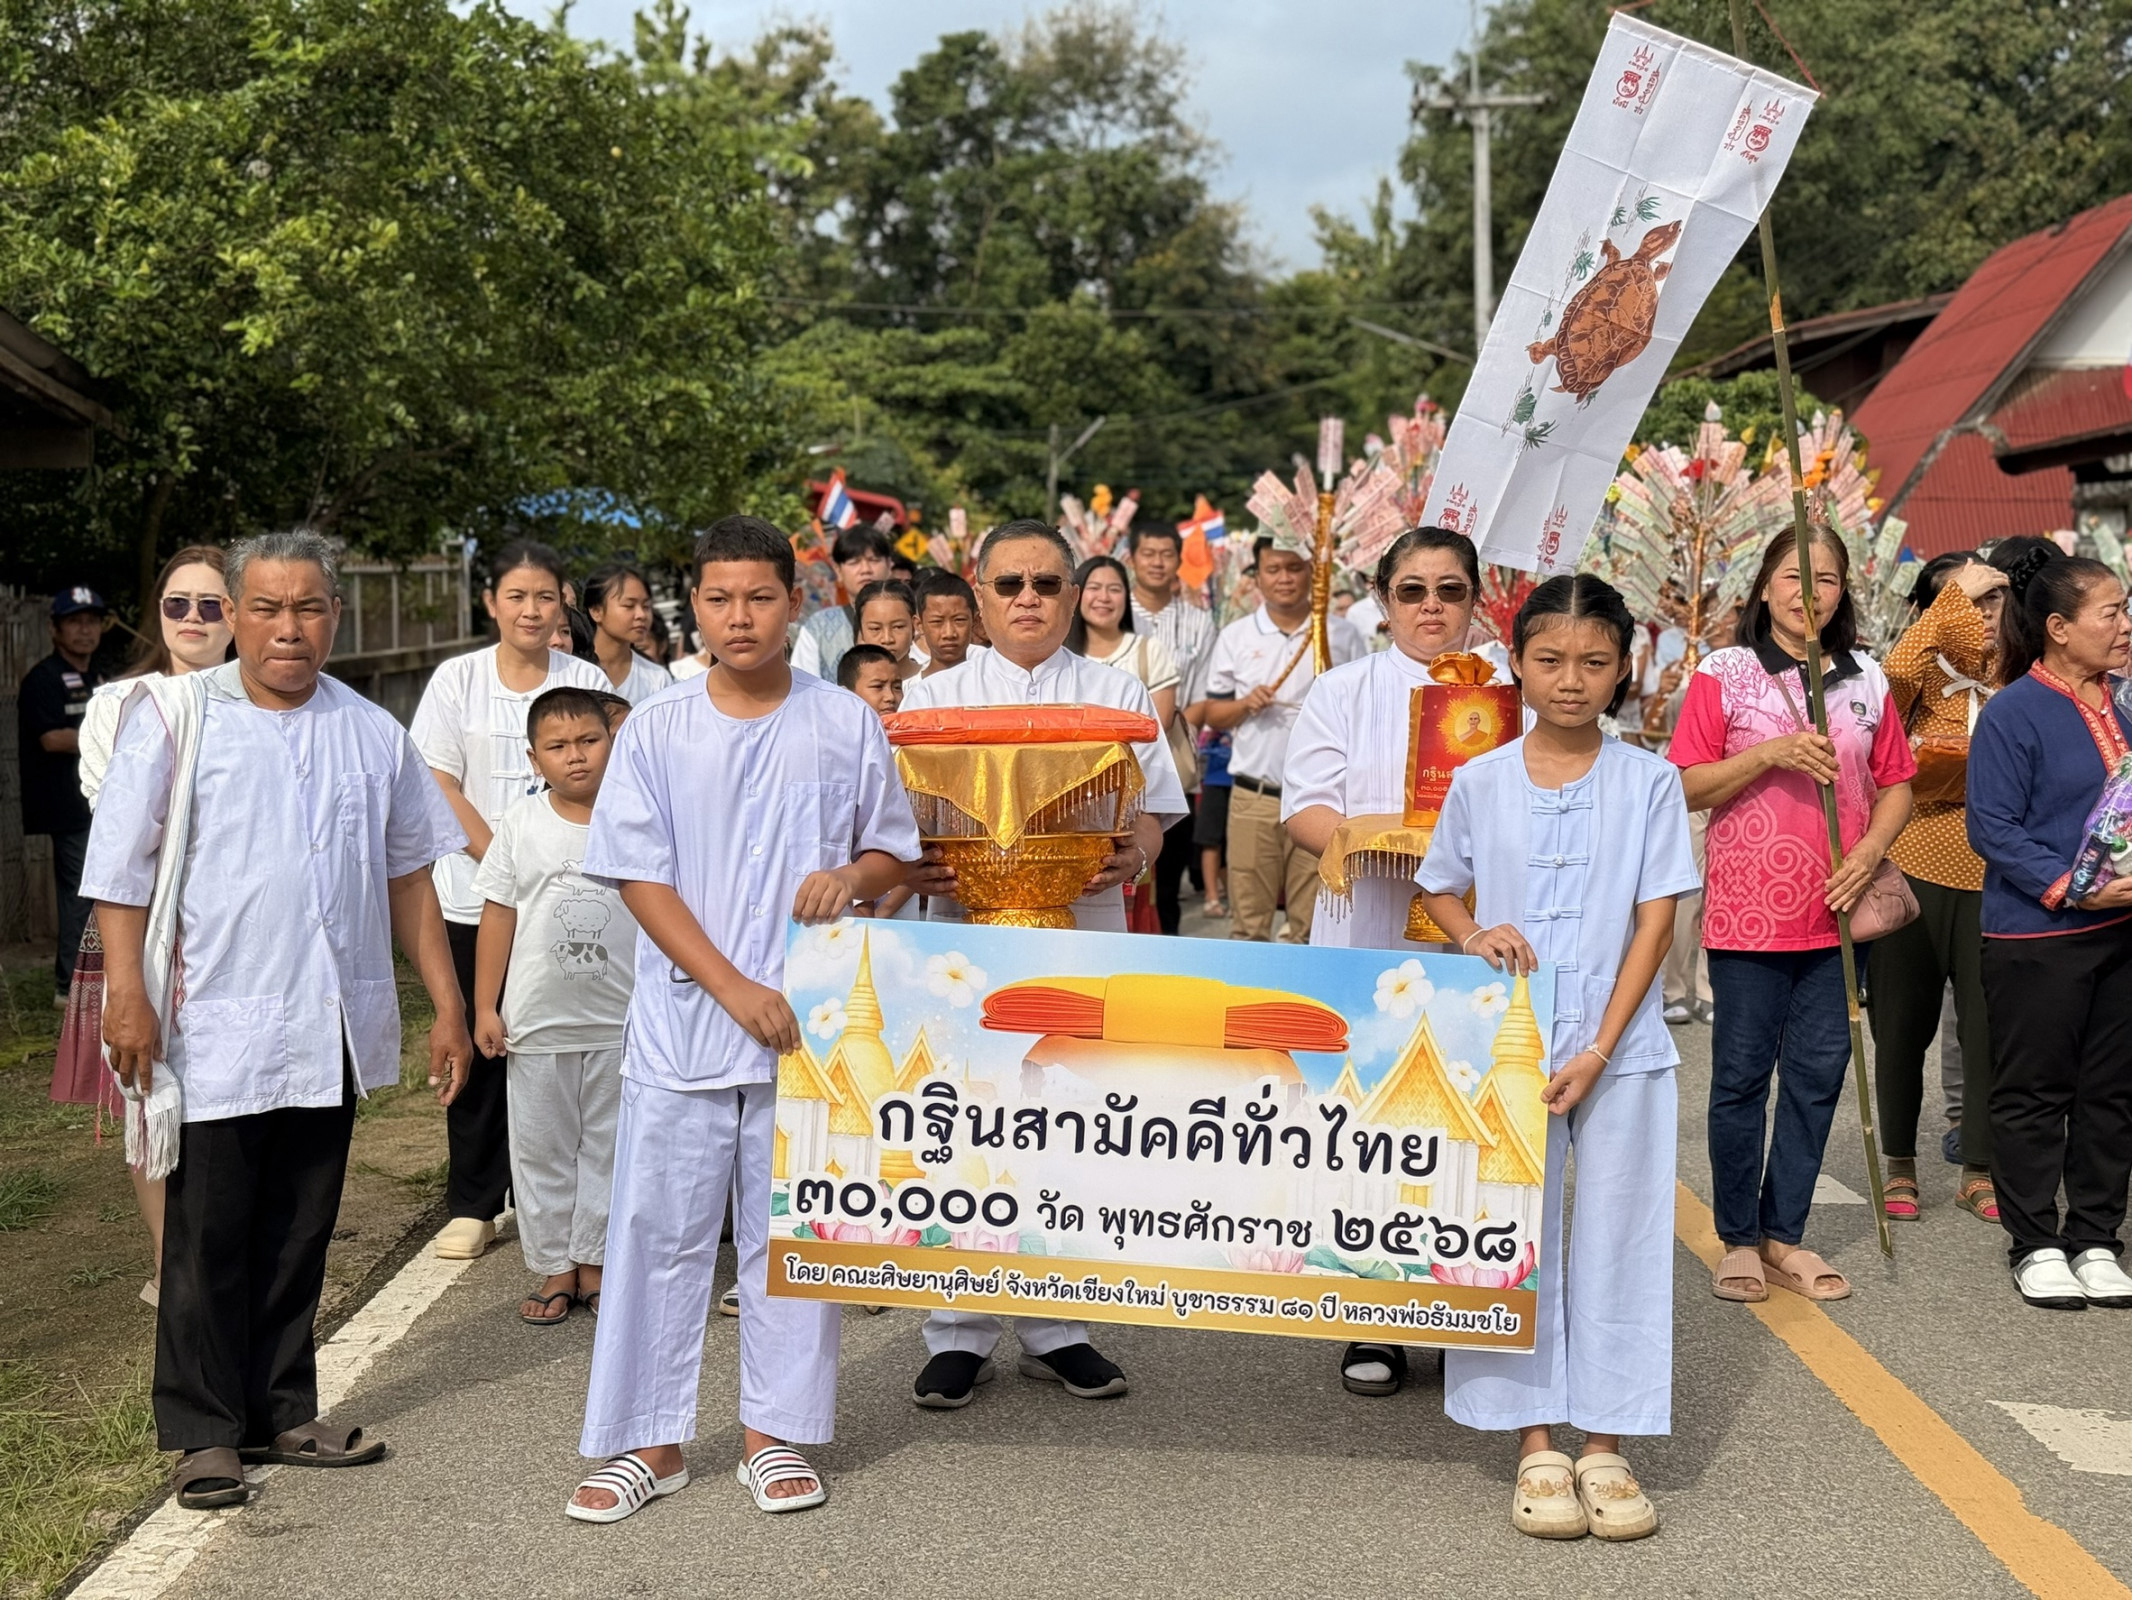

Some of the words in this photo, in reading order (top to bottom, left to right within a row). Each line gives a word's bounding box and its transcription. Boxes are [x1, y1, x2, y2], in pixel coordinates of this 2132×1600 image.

[1422, 766, 1453, 781] กฐินส
[879, 1081, 1438, 1177] กฐินสามัคคีทั่วไทย
[796, 1178, 1019, 1228] ๓๐,๐๐๐
[1037, 1189, 1084, 1232] วัด
[1099, 1200, 1312, 1250] พุทธศักราช
[1332, 1209, 1518, 1262] ๒๕๖๘
[786, 1256, 825, 1281] โดย
[832, 1264, 1000, 1298] คณะศิษยานุศิษย์
[1006, 1275, 1166, 1307] จังหวัดเชียงใหม่
[1174, 1290, 1273, 1316] บูชาธรรม
[1281, 1302, 1314, 1319] ๘๑
[1320, 1301, 1337, 1319] ปี
[1343, 1302, 1518, 1332] หลวงพ่อธัมมชโย
